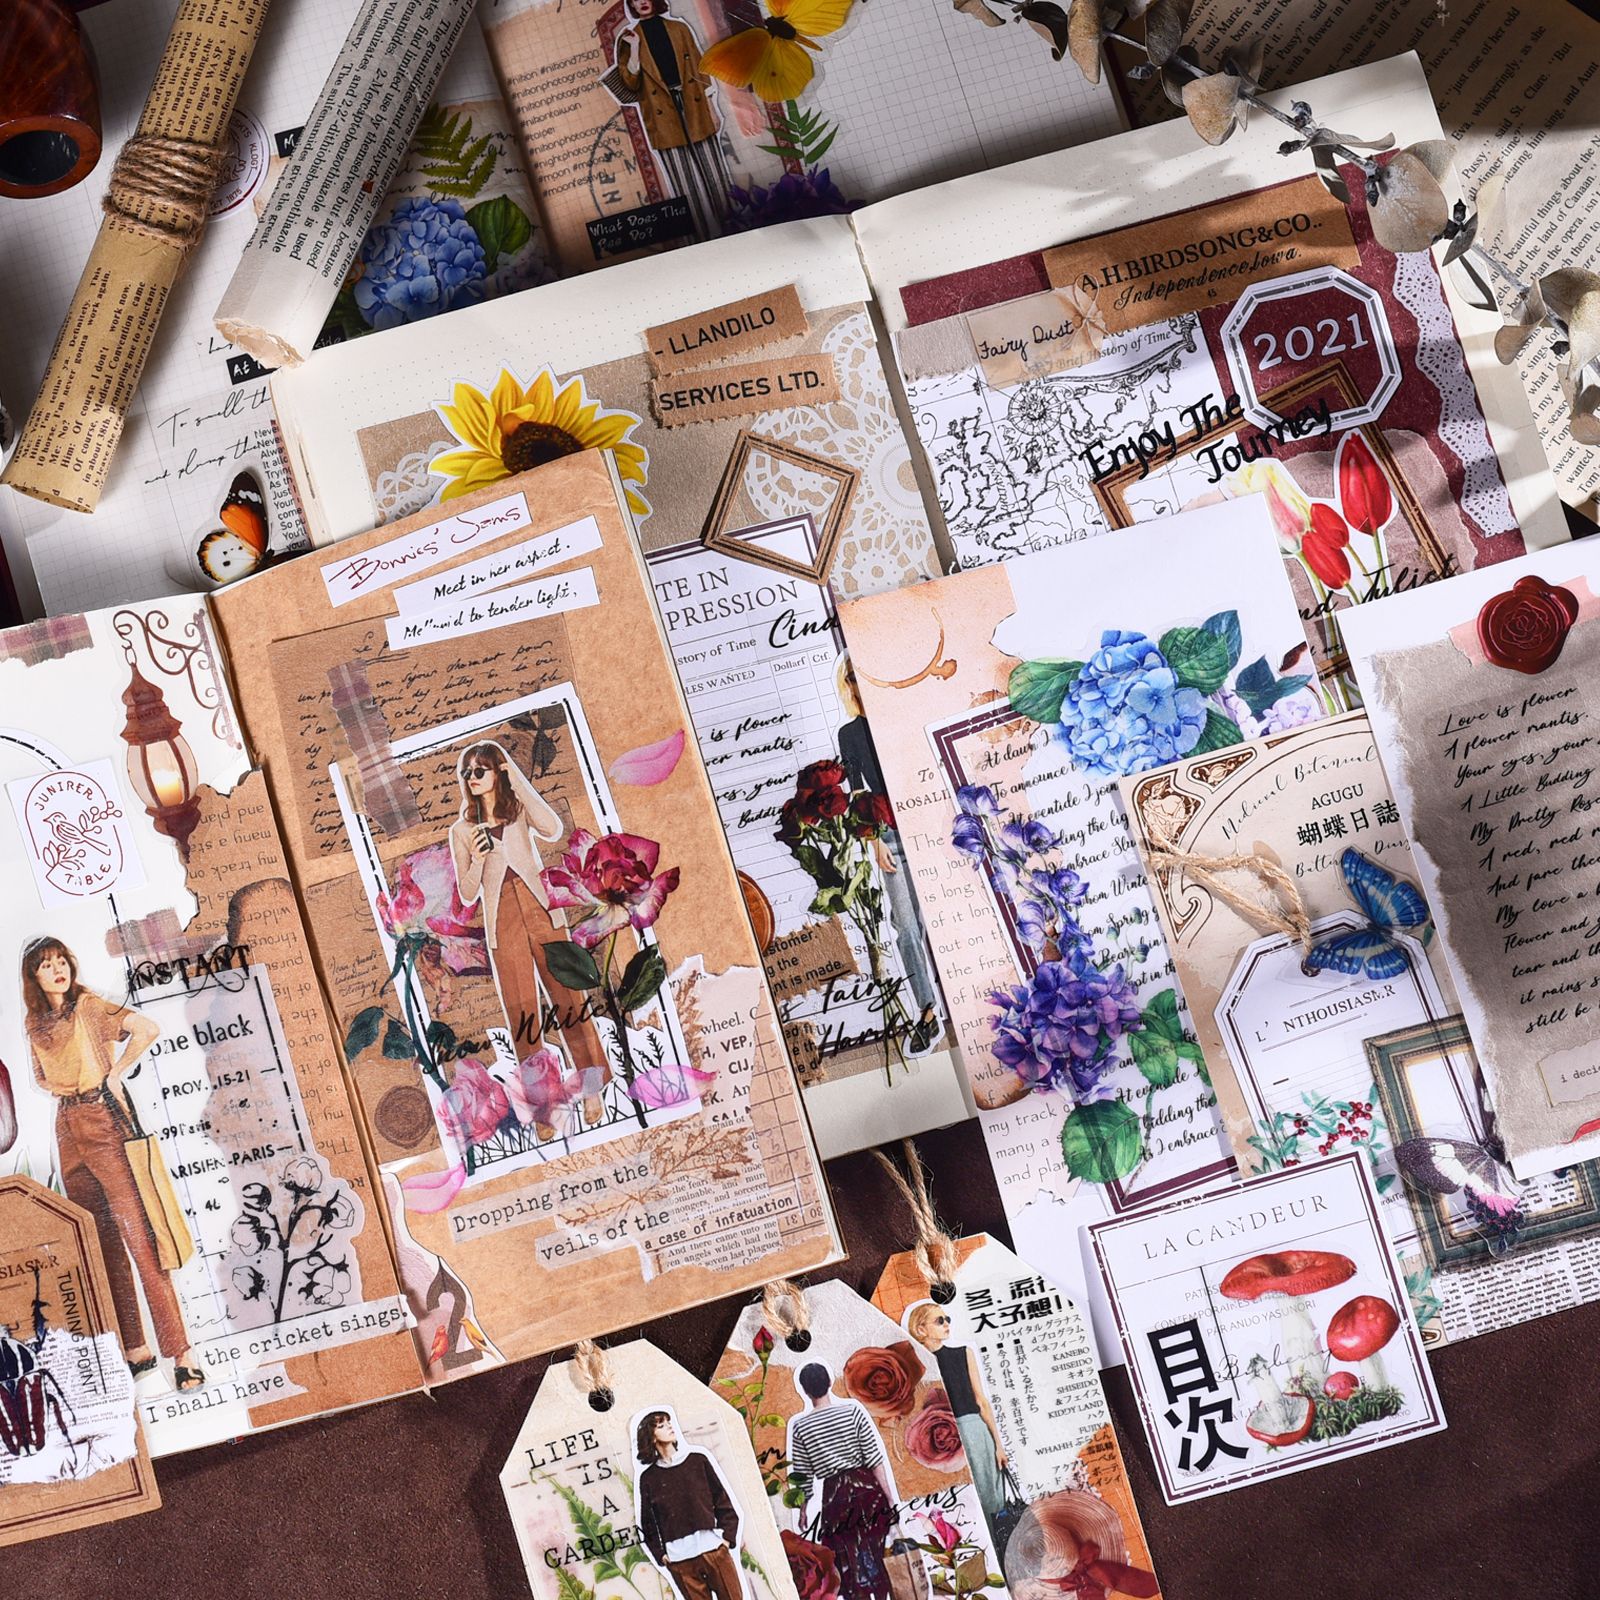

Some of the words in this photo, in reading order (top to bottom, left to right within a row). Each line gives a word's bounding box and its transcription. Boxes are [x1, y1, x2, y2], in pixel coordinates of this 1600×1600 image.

[1467, 56, 1484, 74] one
[1490, 26, 1506, 46] her
[1504, 6, 1521, 27] odd
[1495, 117, 1513, 140] said
[1530, 129, 1547, 150] him
[1503, 217, 1541, 261] beautiful
[1536, 189, 1563, 220] things
[1560, 163, 1584, 191] about
[289, 229, 308, 261] used
[1537, 224, 1558, 245] land
[306, 236, 325, 270] used
[667, 305, 777, 357] LLANDILO
[978, 336, 1029, 362] Fairy
[1032, 320, 1076, 345] Dust
[1144, 329, 1172, 346] Time
[1252, 310, 1370, 371] 2021
[93, 374, 114, 415] Medical
[108, 315, 134, 370] Convention
[776, 368, 827, 397] LTD.
[80, 383, 97, 417] course
[1079, 420, 1178, 484] Enjoy
[1179, 392, 1244, 444] The
[1566, 449, 1595, 485] wanted
[434, 574, 467, 601] Meet
[471, 573, 487, 586] in
[700, 565, 730, 592] IN
[487, 596, 534, 619] tender
[710, 643, 724, 658] of
[728, 636, 758, 654] Time
[705, 669, 756, 690] WANTED
[1437, 711, 1490, 737] Love
[981, 750, 1002, 772] At
[1454, 763, 1497, 790] Your
[1544, 735, 1594, 766] your
[1010, 764, 1069, 796] announce
[1478, 784, 1530, 809] Little
[1536, 766, 1597, 794] Budding
[1026, 787, 1081, 825] eventide
[1310, 781, 1366, 811] AGUGU
[1296, 797, 1402, 848] 蝴蝶日誌
[1469, 822, 1498, 847] My
[907, 832, 946, 854] The
[1549, 827, 1584, 851] red
[942, 881, 975, 903] long
[1486, 875, 1521, 898] And
[1495, 903, 1524, 930] My
[1560, 916, 1590, 935] and
[945, 964, 974, 980] the
[1551, 950, 1582, 969] and
[192, 1013, 254, 1048] black
[700, 1011, 745, 1036] wheel.
[988, 1120, 1009, 1137] my
[1015, 1104, 1058, 1126] track
[1166, 1121, 1220, 1150] embrace
[994, 1141, 1036, 1161] many
[1002, 1166, 1033, 1186] and
[453, 1191, 554, 1234] Dropping
[558, 1176, 609, 1204] from
[613, 1161, 650, 1187] the
[540, 1232, 600, 1261] veils
[606, 1219, 629, 1242] of
[634, 1209, 671, 1234] the
[658, 1231, 688, 1246] case
[693, 1220, 708, 1236] of
[714, 1195, 793, 1228] infatuation
[1141, 1235, 1179, 1261] LA
[1185, 1193, 1330, 1249] CANDEUR
[57, 1270, 85, 1345] TURNING
[73, 1346, 98, 1396] POINT
[203, 1338, 243, 1368] the
[248, 1320, 335, 1357] cricket
[339, 1306, 411, 1342] sings.
[1051, 1356, 1094, 1374] SHISEIDO
[1052, 1345, 1091, 1362] KANEBO
[146, 1405, 159, 1425] I
[165, 1387, 228, 1421] shall
[231, 1372, 285, 1400] have
[1056, 1377, 1099, 1395] SHISEIDO
[1147, 1317, 1250, 1472] 目次
[1078, 1399, 1104, 1413] LAND
[525, 1428, 600, 1471] LIFE
[580, 1458, 614, 1486] IS
[600, 1493, 621, 1518] A
